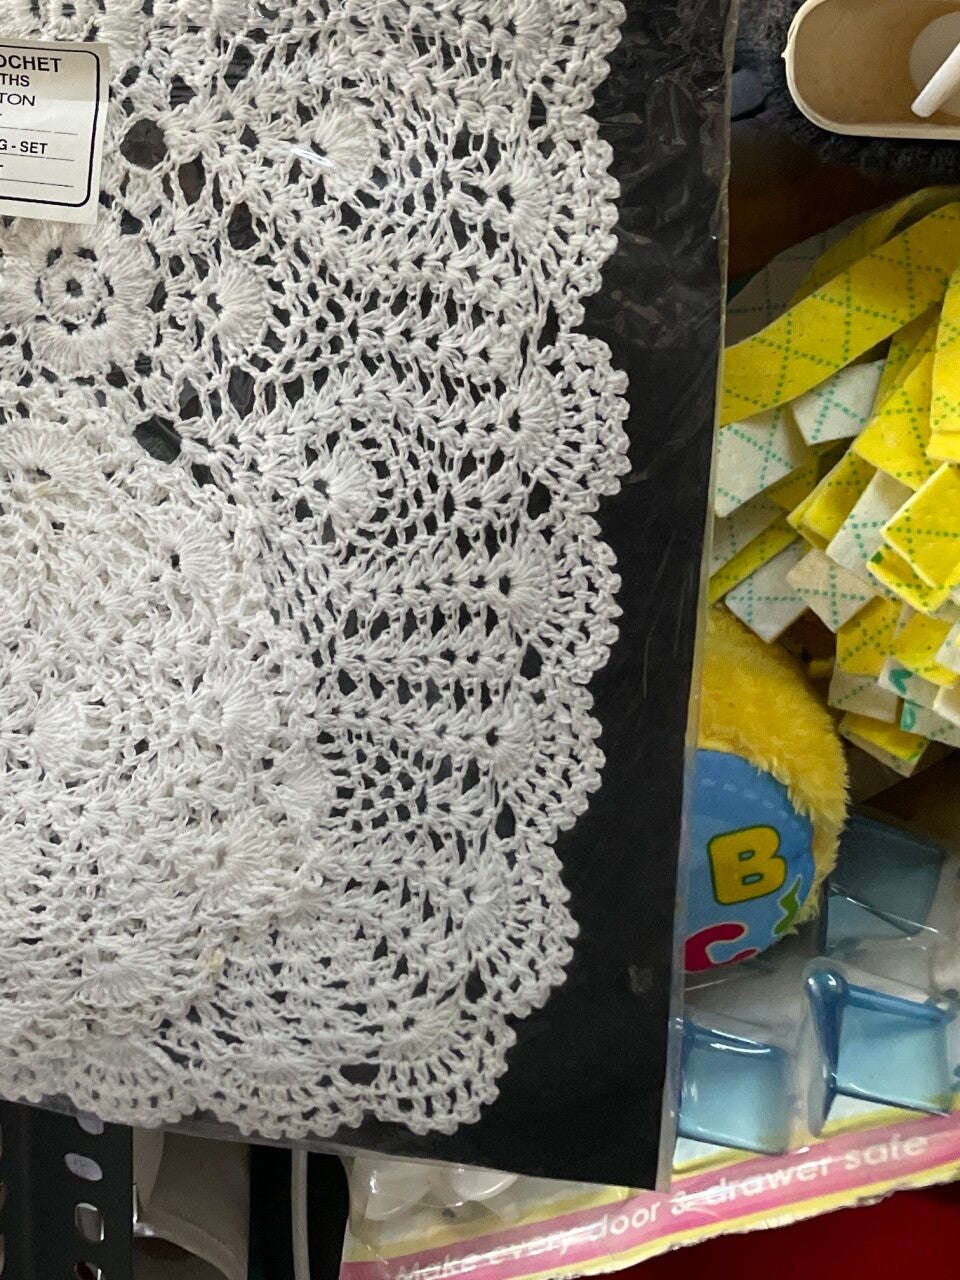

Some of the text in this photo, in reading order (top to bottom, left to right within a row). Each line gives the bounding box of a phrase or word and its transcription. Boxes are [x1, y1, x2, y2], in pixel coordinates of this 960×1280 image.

[19, 141, 48, 155] SET
[587, 1200, 661, 1244] door
[702, 1157, 832, 1207] drawer
[843, 1133, 930, 1172] safe
